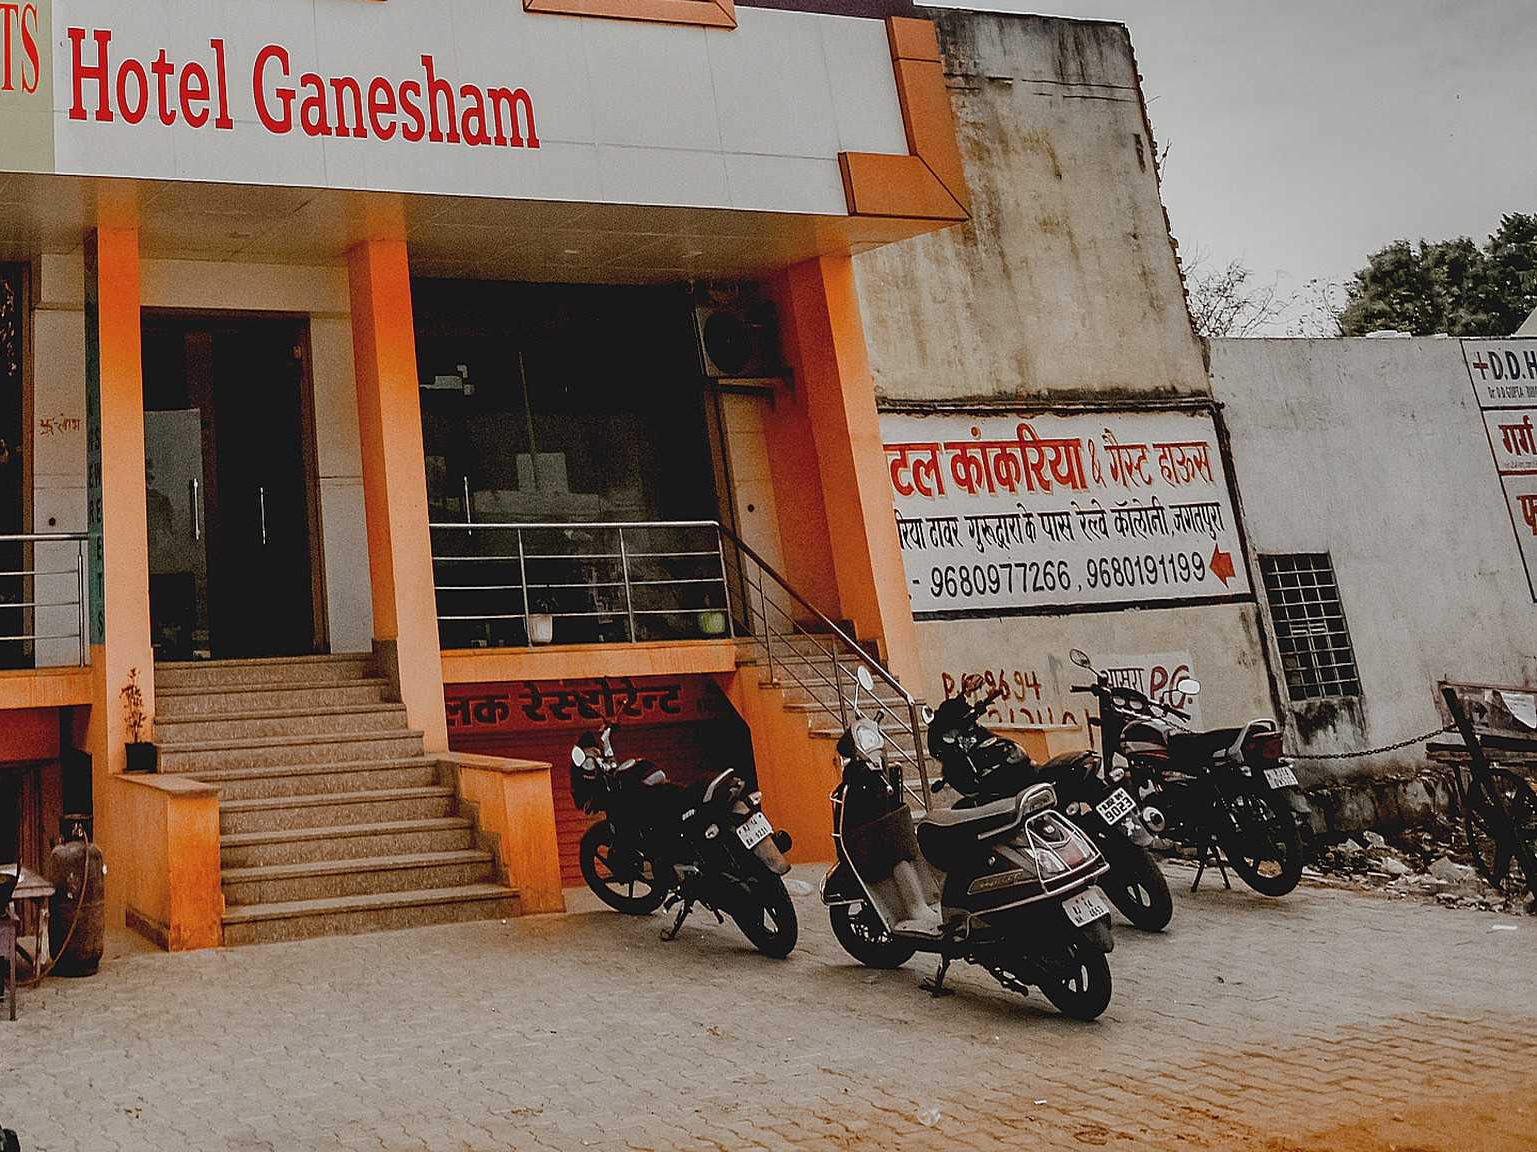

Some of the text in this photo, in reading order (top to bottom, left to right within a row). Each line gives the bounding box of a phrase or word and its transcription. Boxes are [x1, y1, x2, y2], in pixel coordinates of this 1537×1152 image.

[67, 27, 541, 149] Hotel Ganesham
[883, 442, 947, 496] टल
[894, 508, 928, 550] रिया
[1104, 796, 1134, 823] 9023
